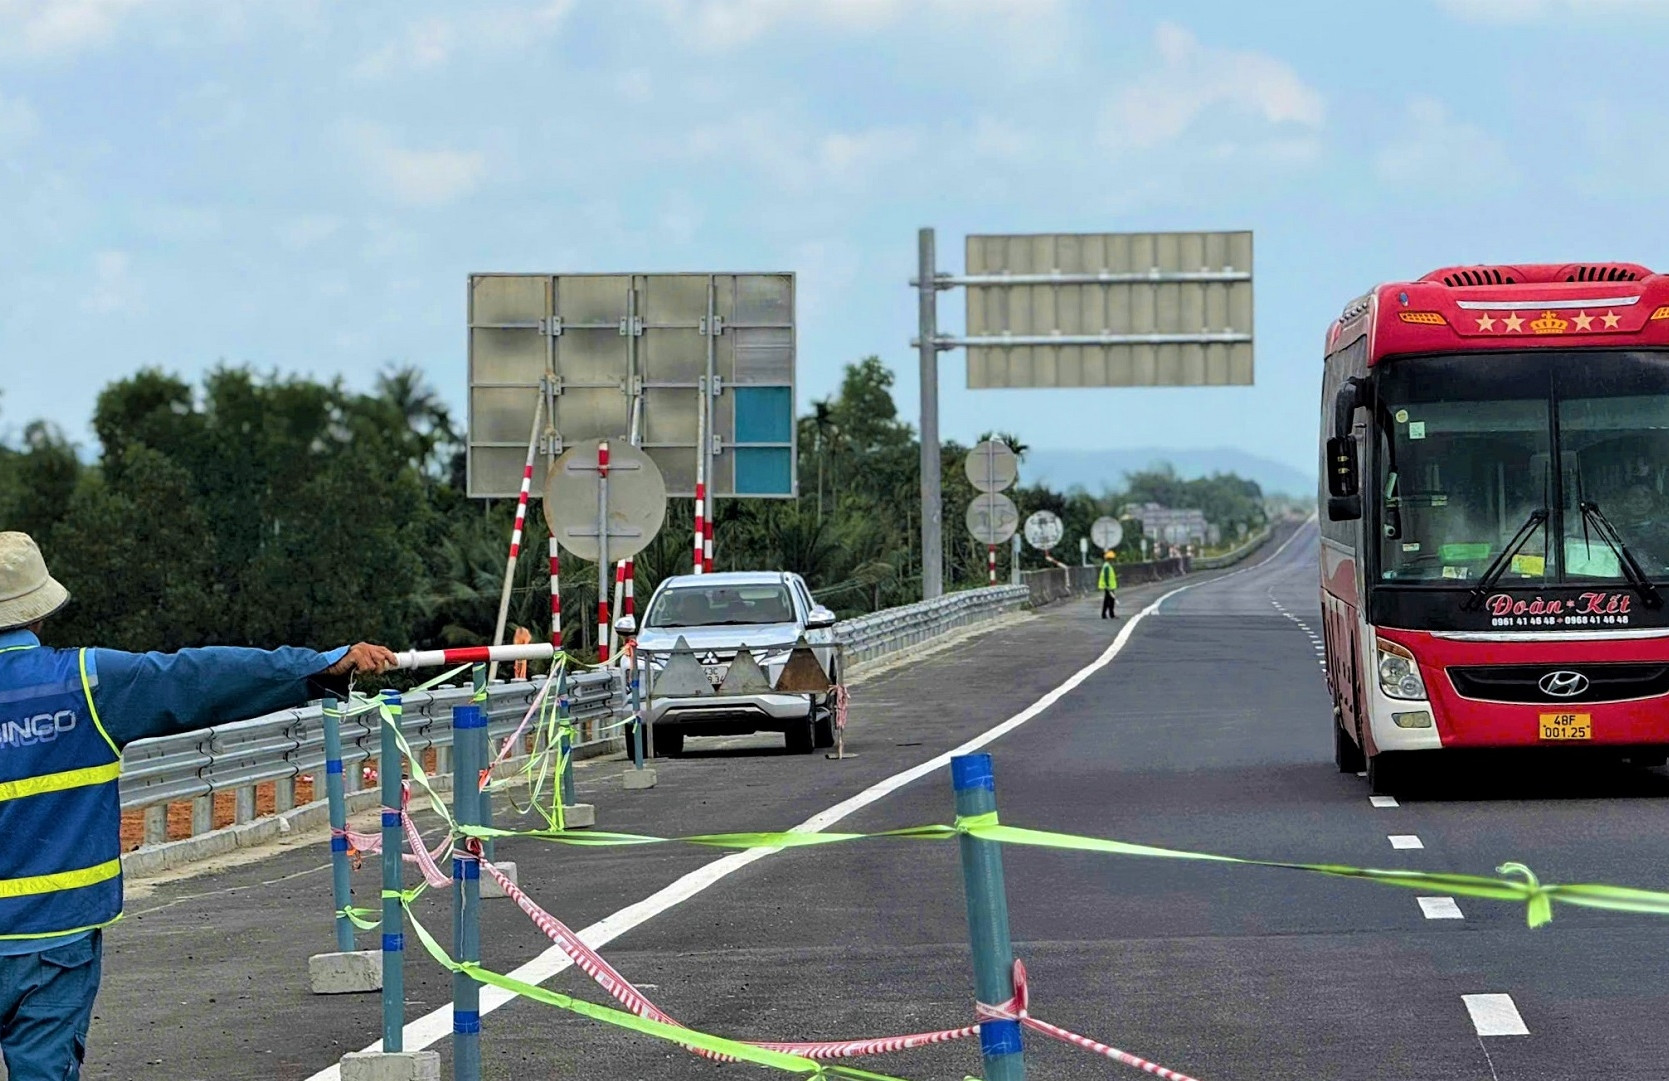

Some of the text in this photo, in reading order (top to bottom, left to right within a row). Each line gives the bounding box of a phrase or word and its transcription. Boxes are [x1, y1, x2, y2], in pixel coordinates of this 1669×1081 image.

[1485, 592, 1631, 616] Đoàn Kết
[1491, 617, 1513, 626] 0961
[1516, 617, 1527, 625] 41
[1543, 616, 1555, 625] 48
[1589, 616, 1600, 624] 41
[1616, 615, 1629, 624] 48
[1554, 715, 1576, 725] 48F
[1545, 727, 1585, 737] 001.25
